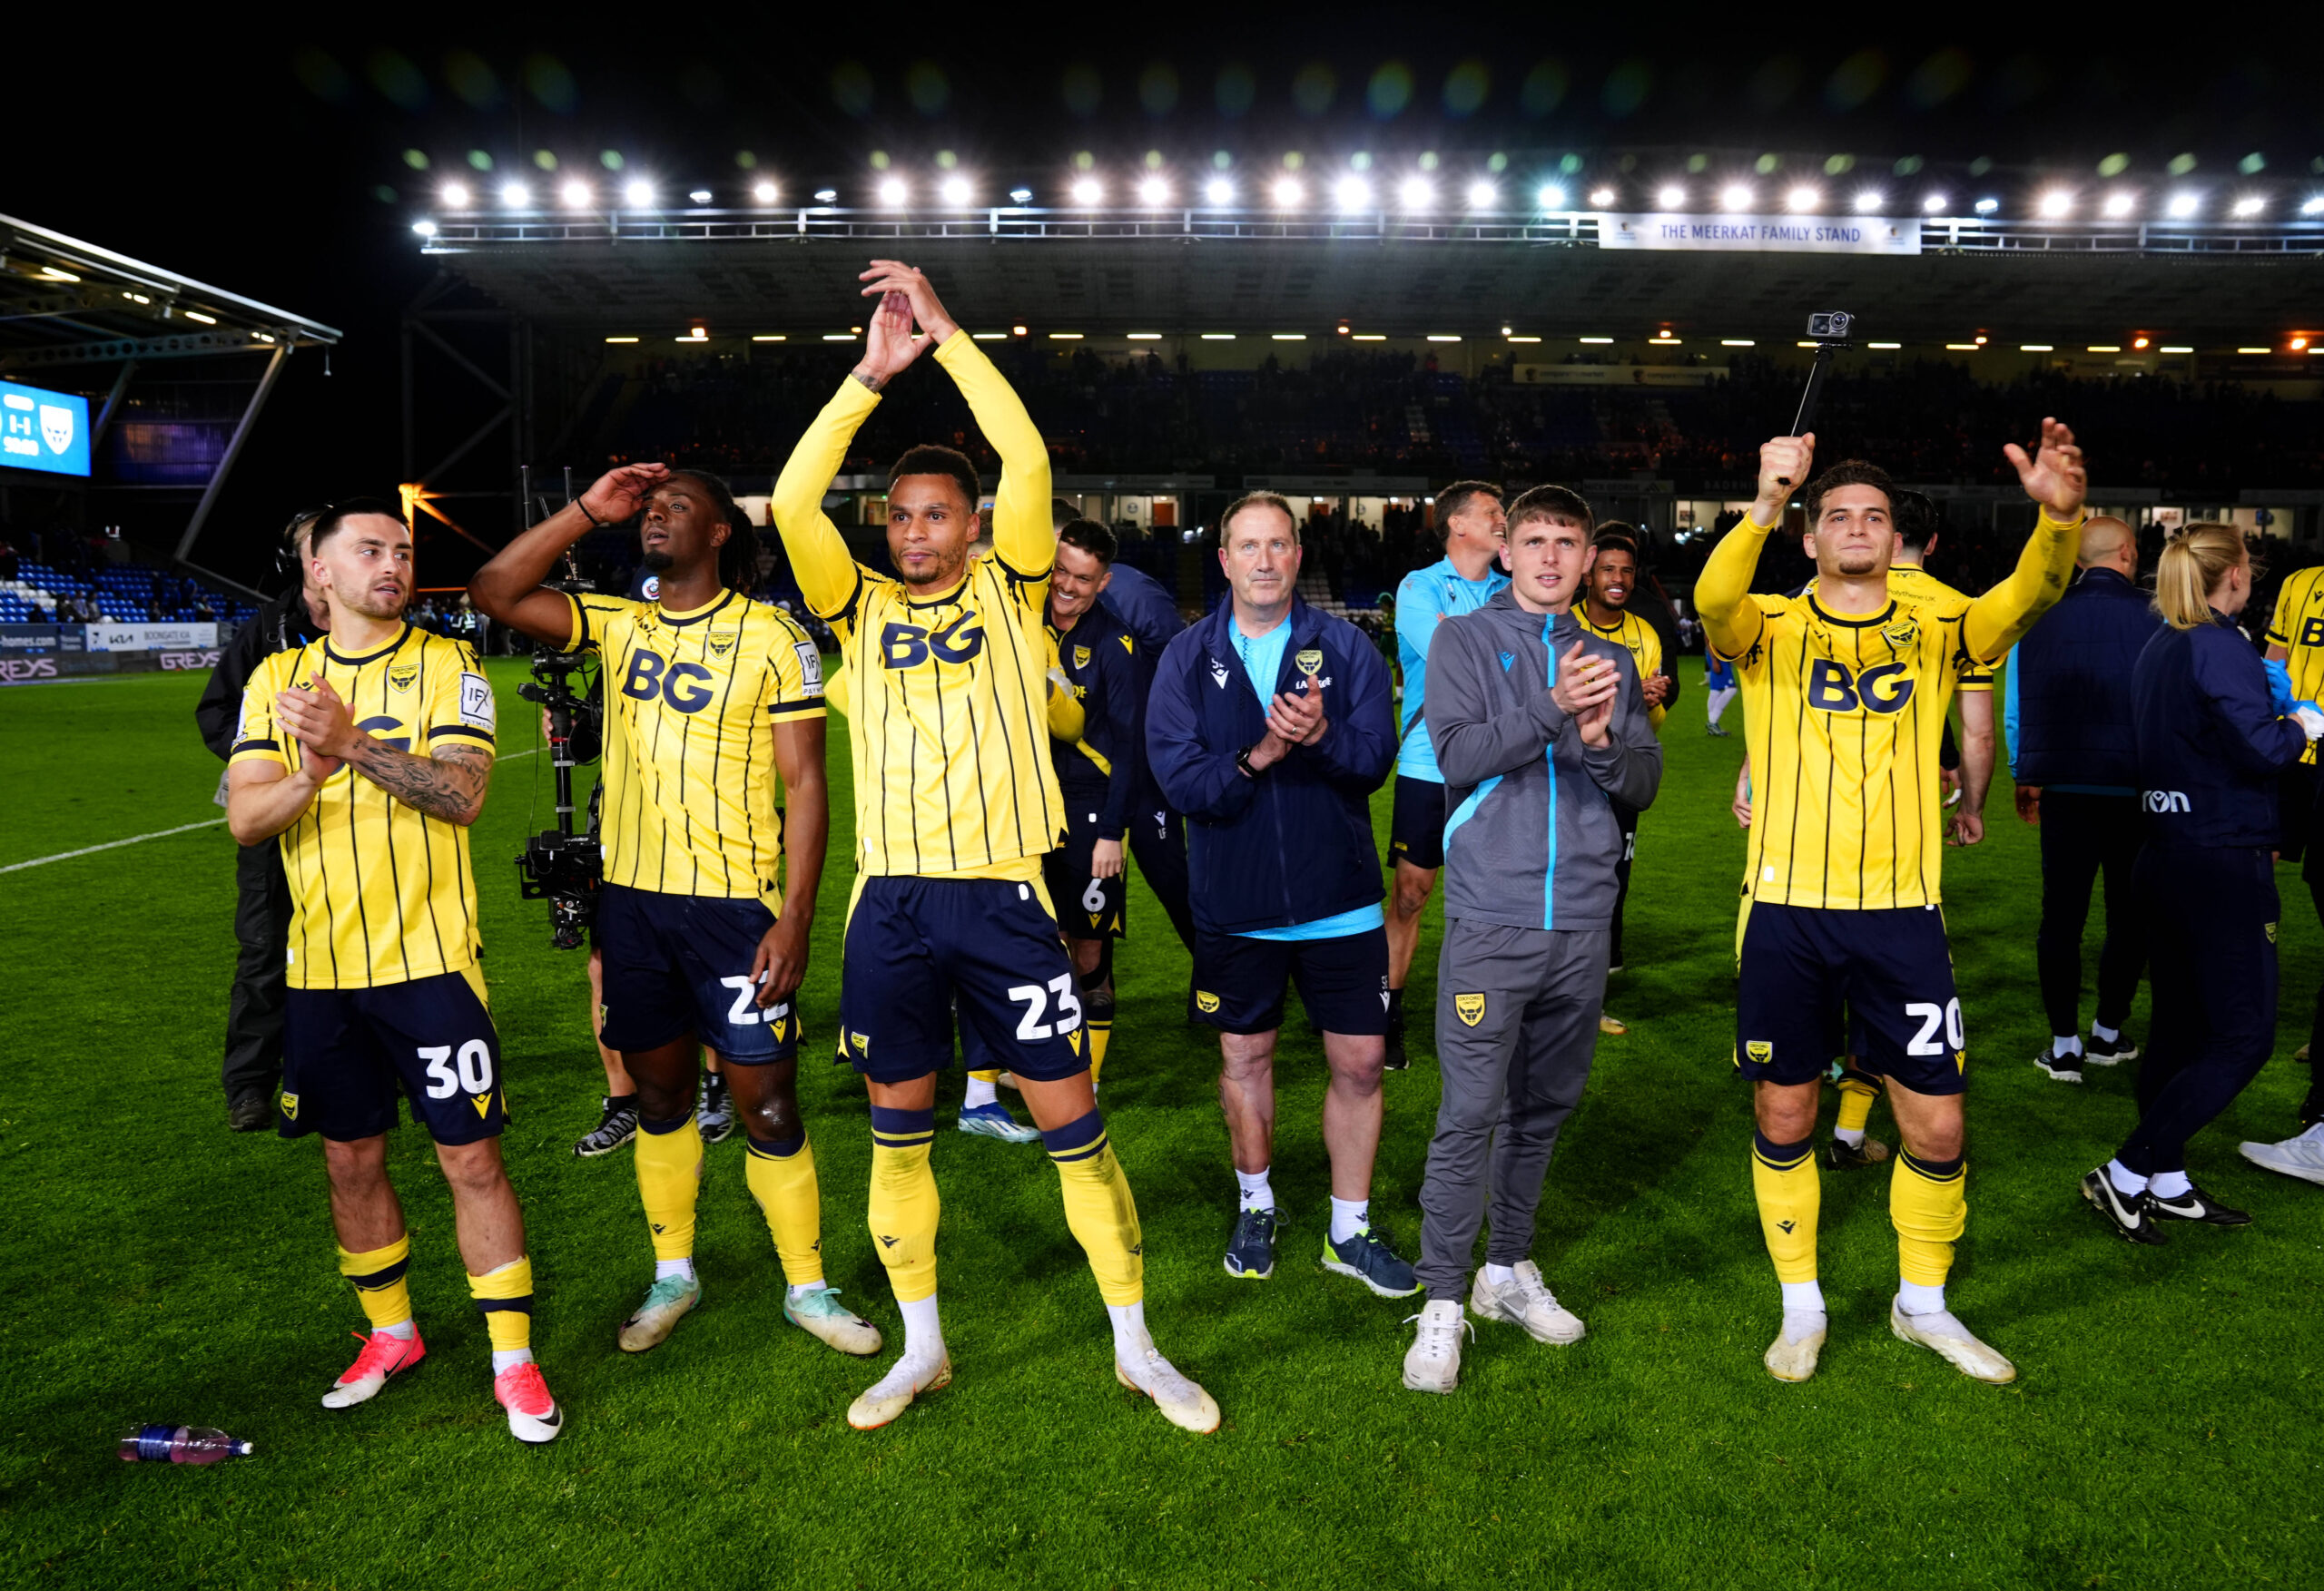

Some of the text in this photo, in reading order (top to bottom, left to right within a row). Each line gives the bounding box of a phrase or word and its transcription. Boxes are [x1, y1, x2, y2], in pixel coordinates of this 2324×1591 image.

[1661, 224, 1860, 242] THE MEERKAT FAMILY STAND
[881, 610, 984, 669] BG
[622, 647, 714, 713] BG
[1807, 658, 1915, 713] BG
[1082, 878, 1106, 913] 6
[1008, 972, 1081, 1041] 23
[1905, 997, 1965, 1056] 20
[417, 1038, 493, 1100] 30
